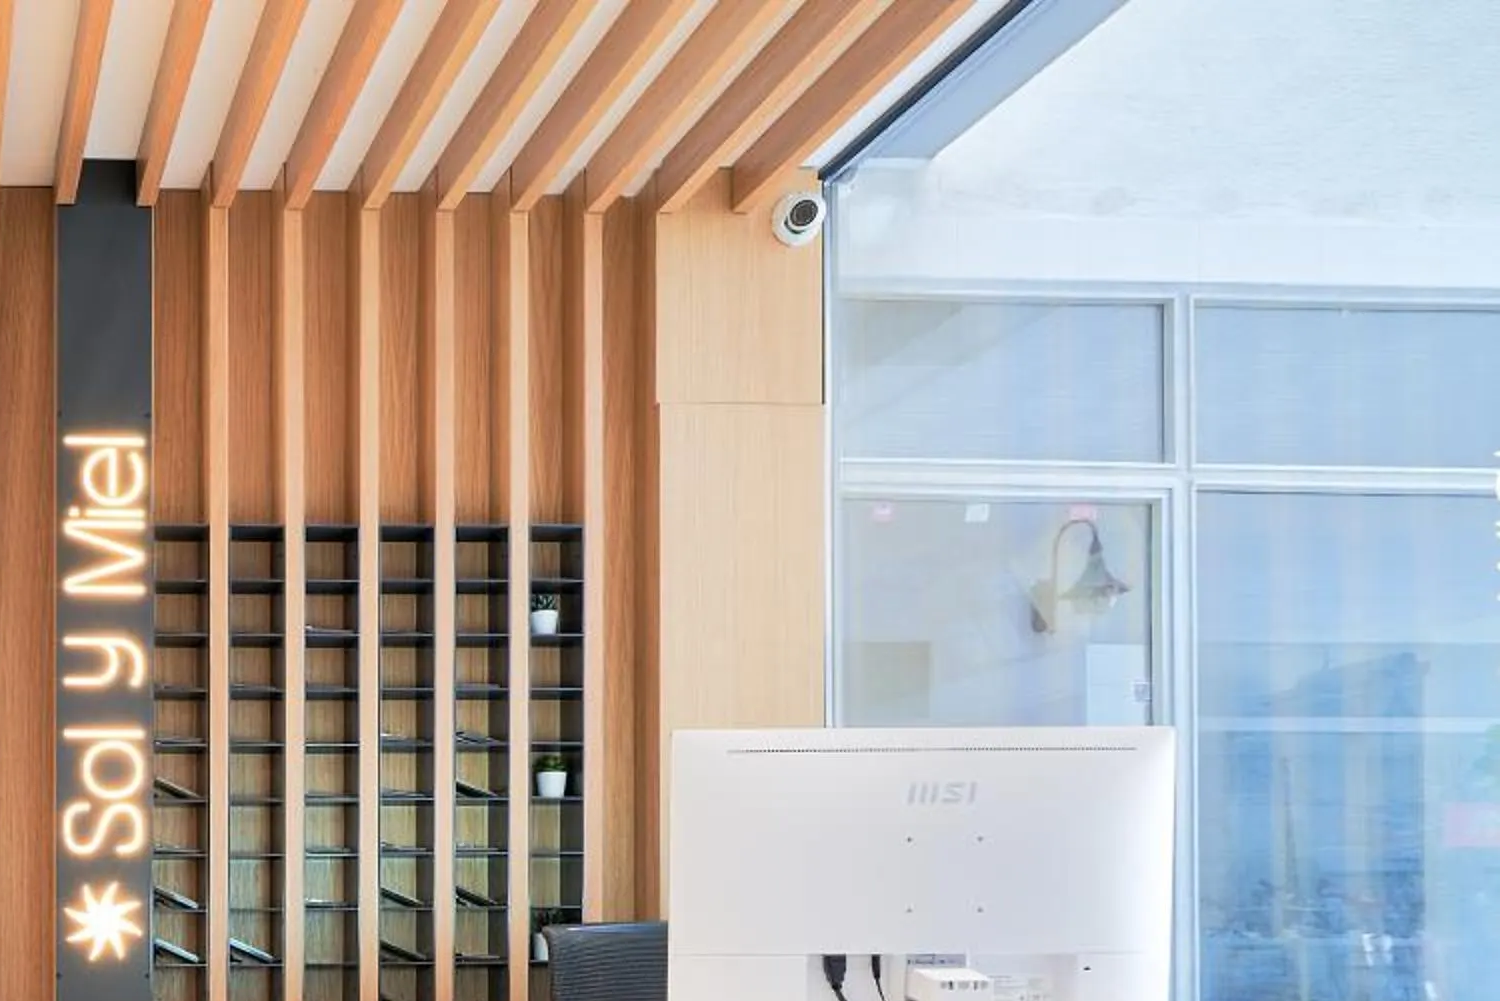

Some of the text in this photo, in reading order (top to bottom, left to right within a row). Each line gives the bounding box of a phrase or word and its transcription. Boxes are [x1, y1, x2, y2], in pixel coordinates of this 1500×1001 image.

[62, 434, 147, 856] Sol y Miel
[907, 781, 978, 805] MSI
